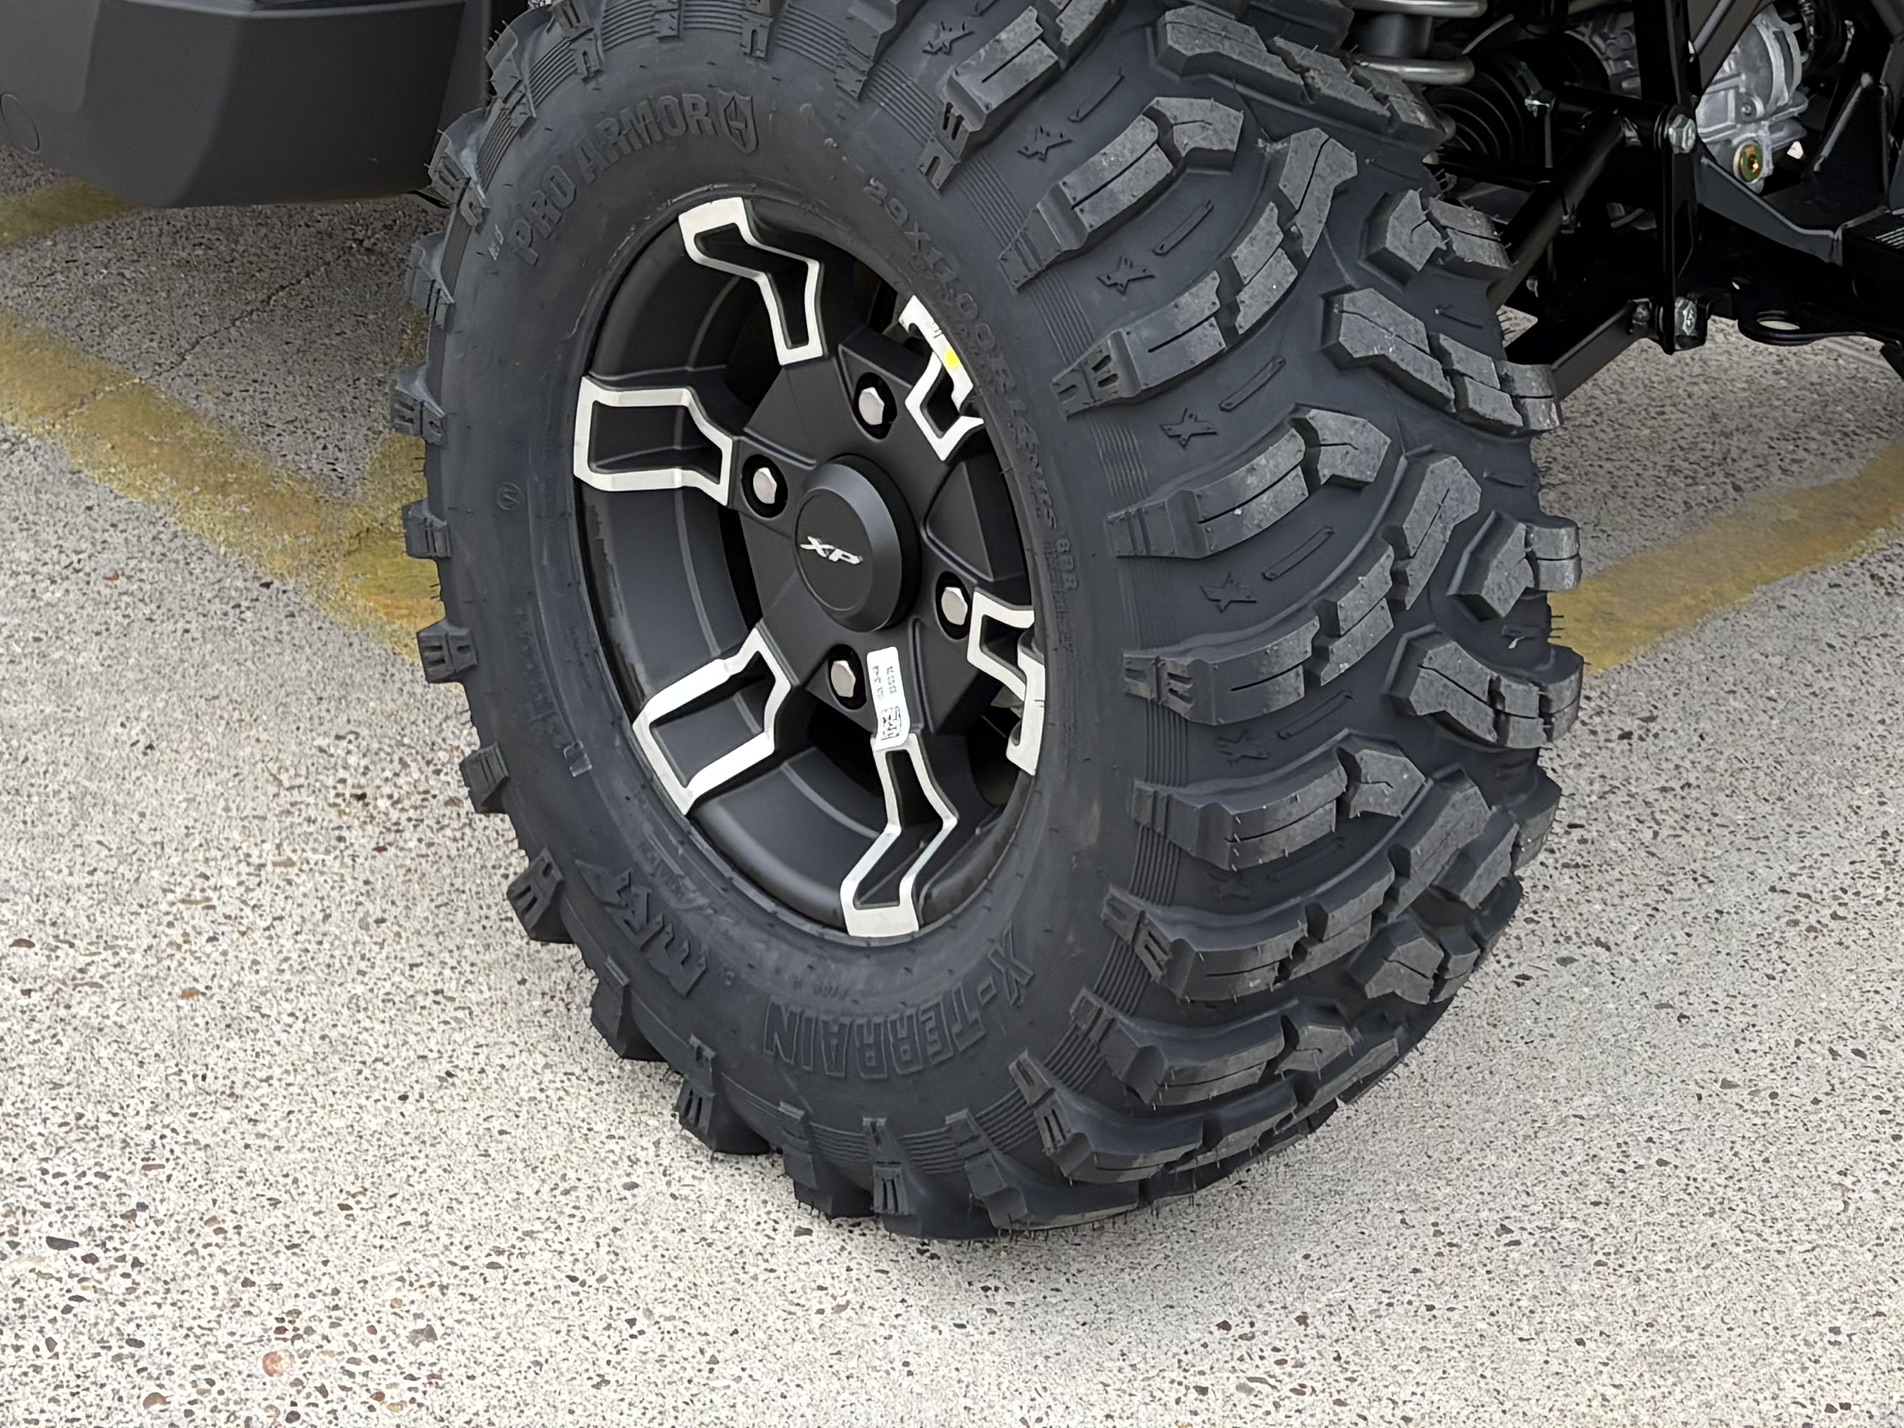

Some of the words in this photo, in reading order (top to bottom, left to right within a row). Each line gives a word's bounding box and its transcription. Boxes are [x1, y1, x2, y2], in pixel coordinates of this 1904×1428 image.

[507, 164, 577, 267] PRO
[573, 92, 718, 185] ARMOR
[799, 535, 864, 565] XP
[763, 927, 1036, 1081] X-TERRAIN
